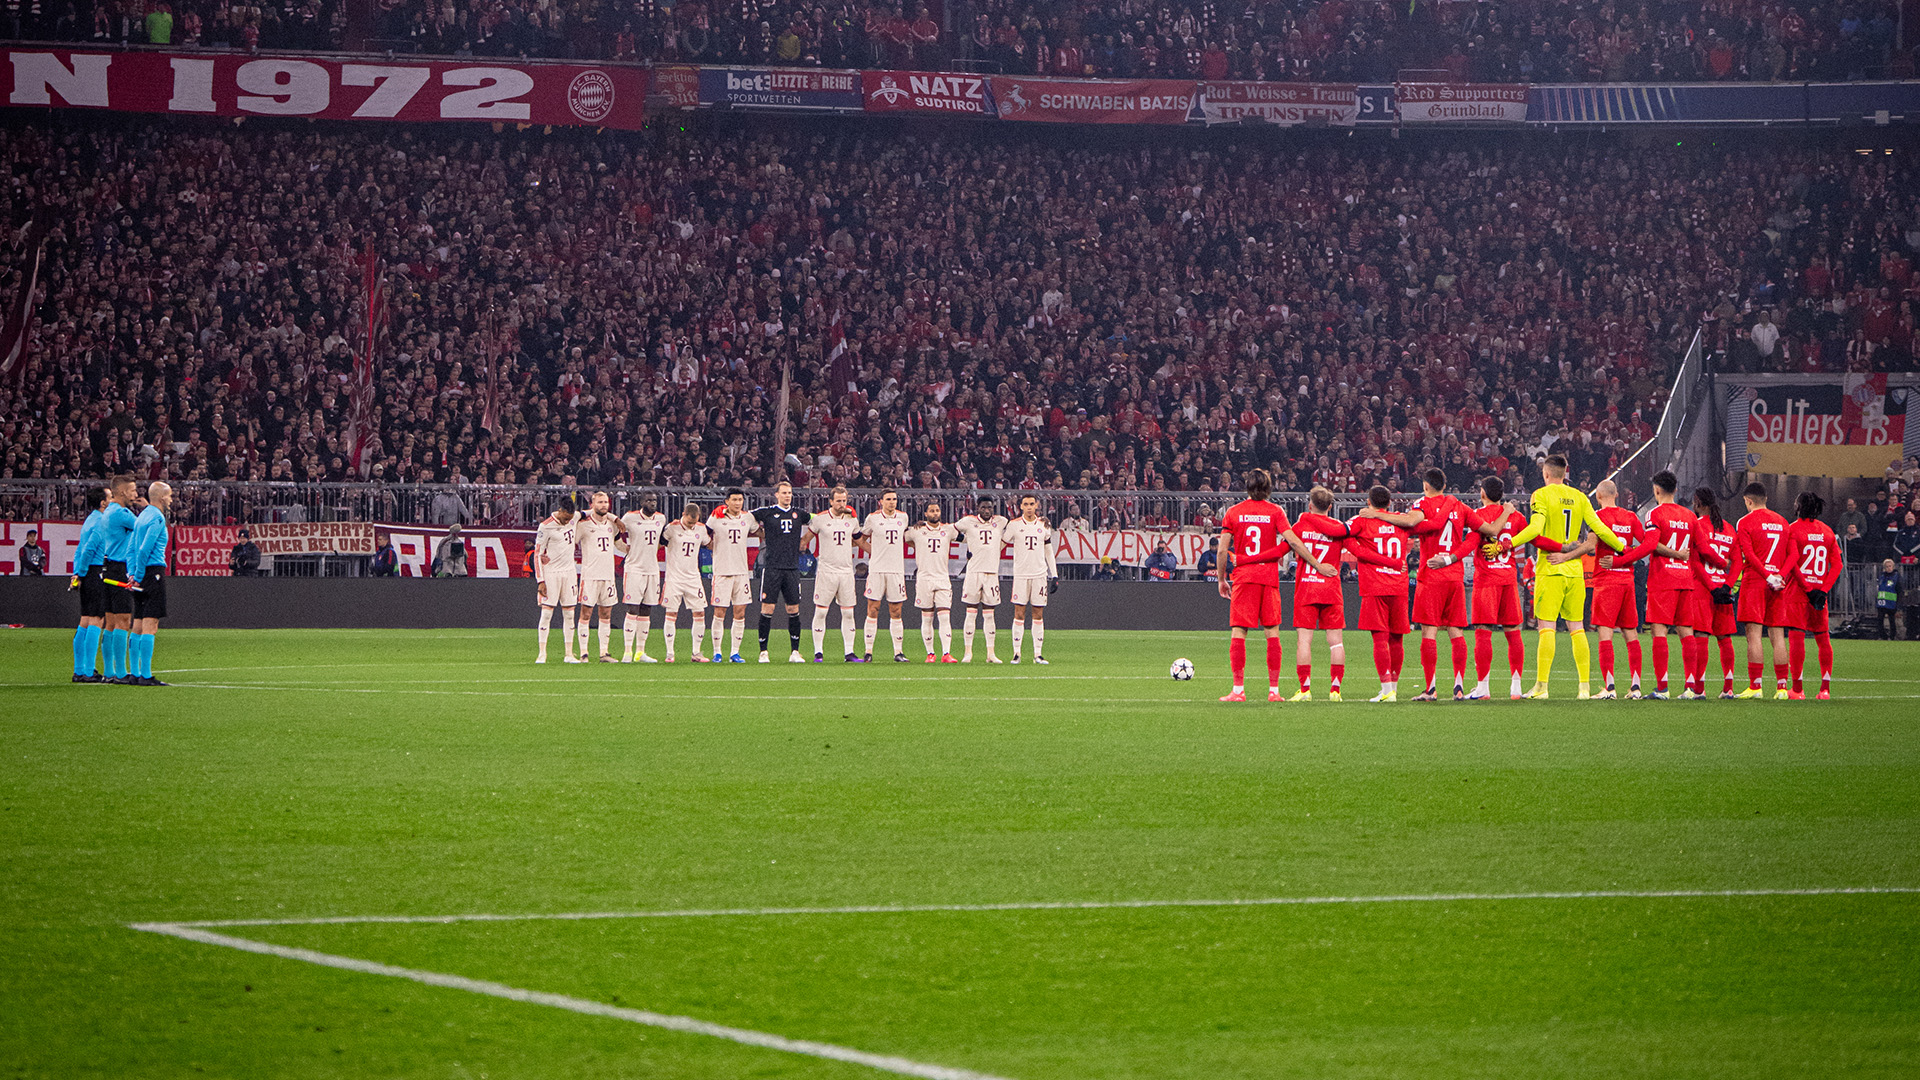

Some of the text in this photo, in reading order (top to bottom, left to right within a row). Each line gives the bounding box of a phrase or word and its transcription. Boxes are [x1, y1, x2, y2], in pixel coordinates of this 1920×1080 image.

[9, 52, 534, 120] N 1972
[771, 74, 853, 90] LETZTE REIHE
[909, 75, 983, 99] NATZ
[727, 93, 801, 104] SPORTWETTEN
[1206, 85, 1232, 99] Rot
[1245, 86, 1298, 101] Weisse
[1404, 86, 1526, 101] Red Supporters
[1040, 94, 1135, 111] SCHWABEN
[1428, 104, 1505, 118] Gründlach
[1751, 398, 1845, 446] Selters
[250, 522, 374, 538] AUSGESPERRTE
[781, 519, 792, 533] T
[1562, 509, 1572, 541] 1
[645, 530, 656, 545] T
[729, 529, 741, 544] T
[833, 531, 845, 546] T
[885, 530, 898, 544] T
[980, 530, 992, 545] T
[1025, 536, 1037, 550] T
[1246, 526, 1261, 556] 3
[1439, 520, 1452, 551] 4
[257, 538, 372, 553] MMER BEI UNS
[597, 537, 609, 552] T
[682, 542, 695, 557] T
[928, 538, 940, 553] T
[1373, 537, 1401, 559] 10
[1765, 533, 1780, 564] 7
[177, 548, 232, 565] GEGE
[1800, 544, 1827, 576] 28
